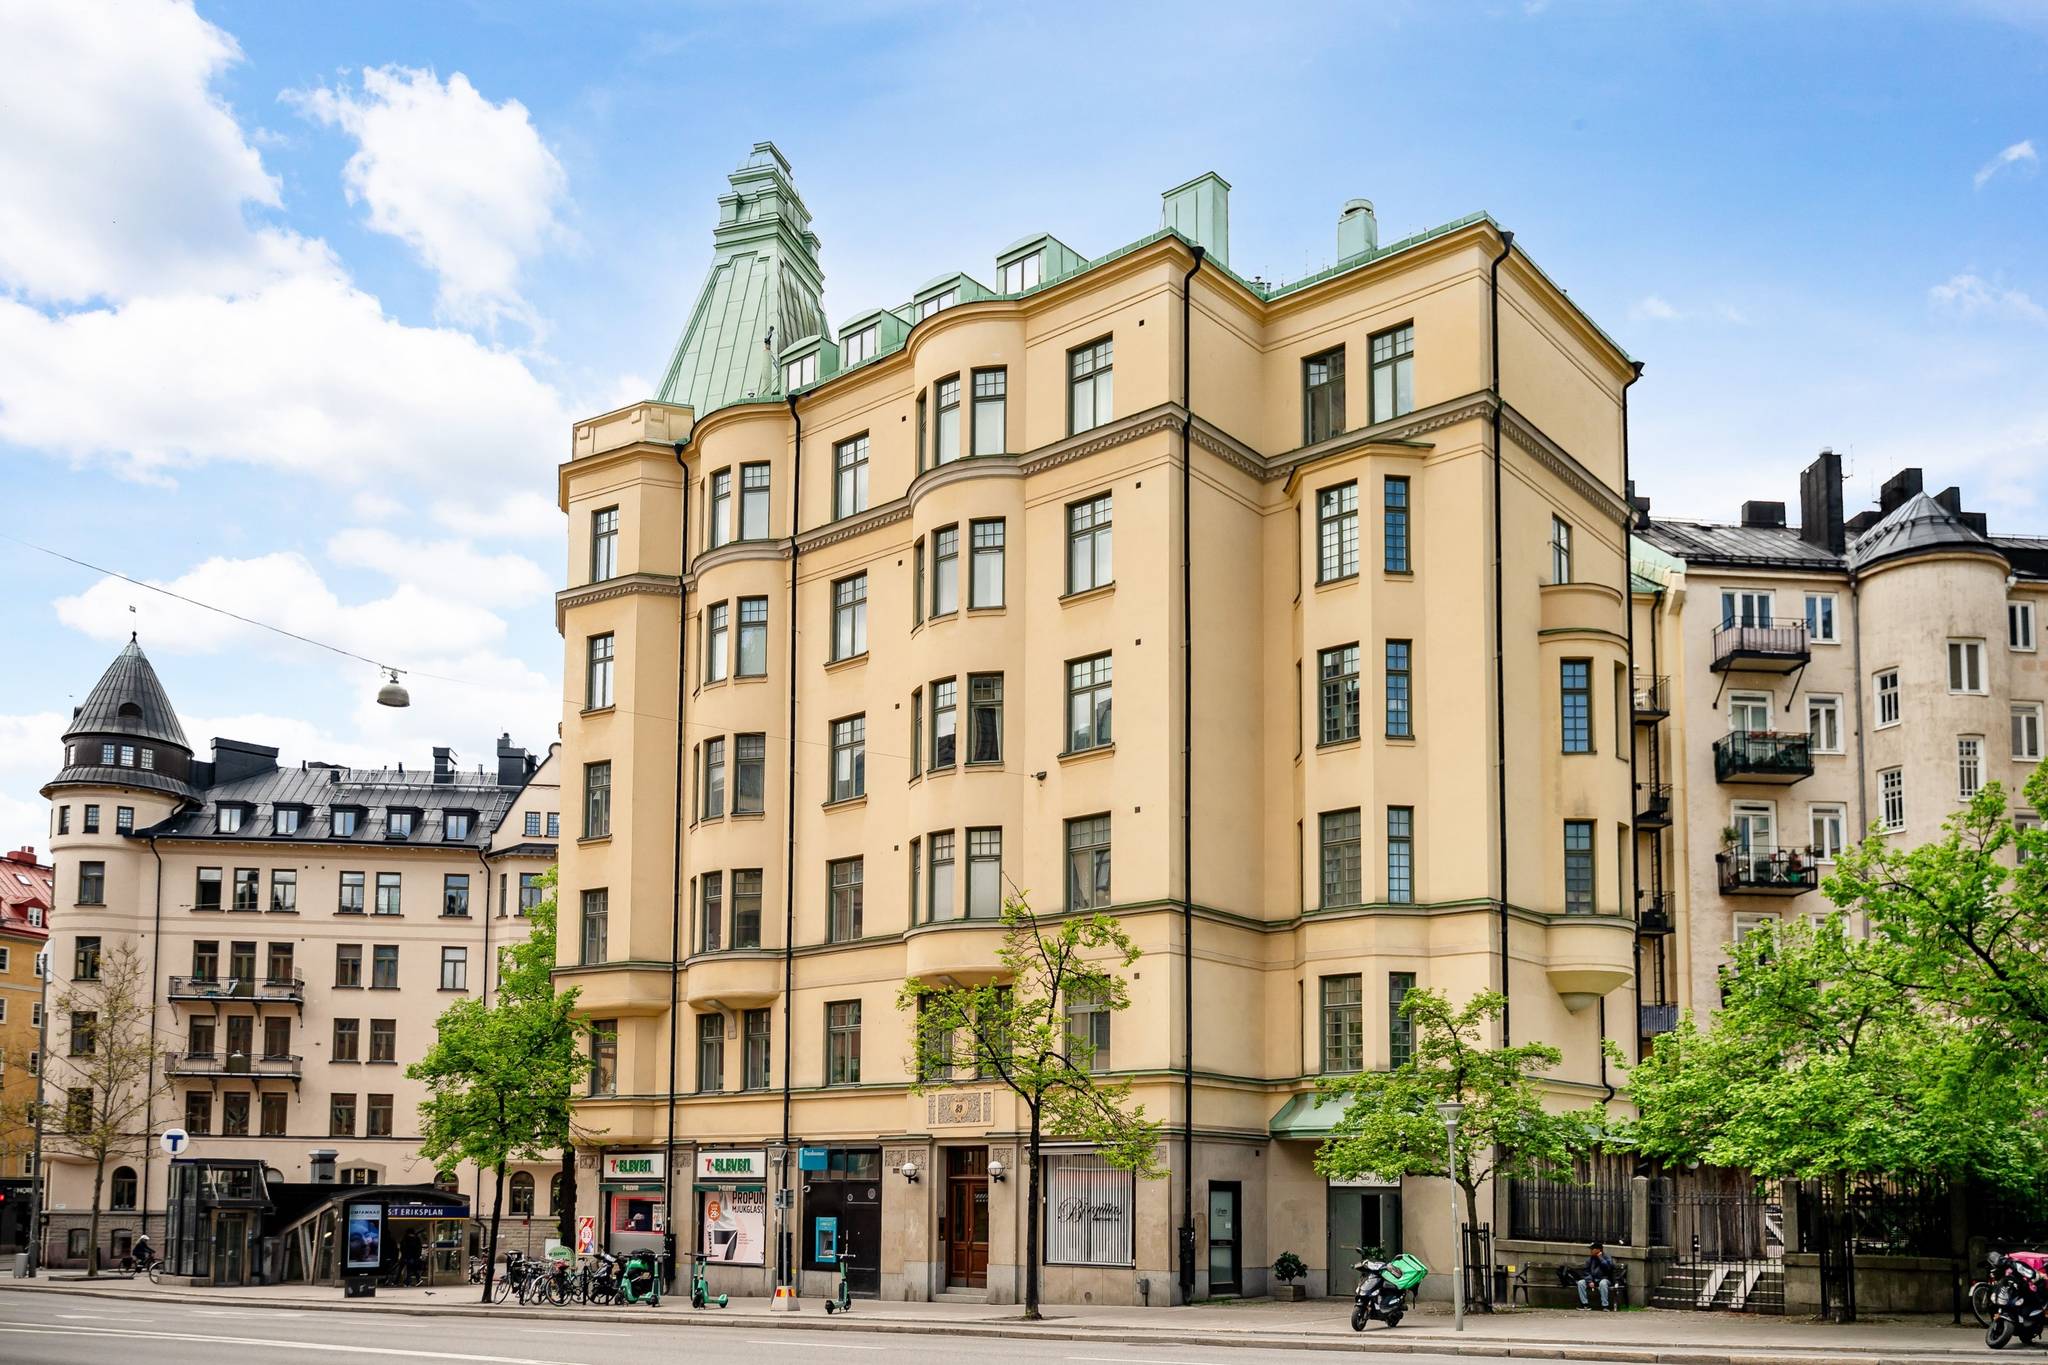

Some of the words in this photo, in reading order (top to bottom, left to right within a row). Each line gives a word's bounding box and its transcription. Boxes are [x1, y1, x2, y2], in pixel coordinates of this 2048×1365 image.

[167, 1135, 183, 1151] T
[611, 1159, 653, 1173] 7-ELEVEN
[705, 1158, 752, 1173] 7-ELEVEN
[400, 1208, 443, 1216] ERIKSPLAN
